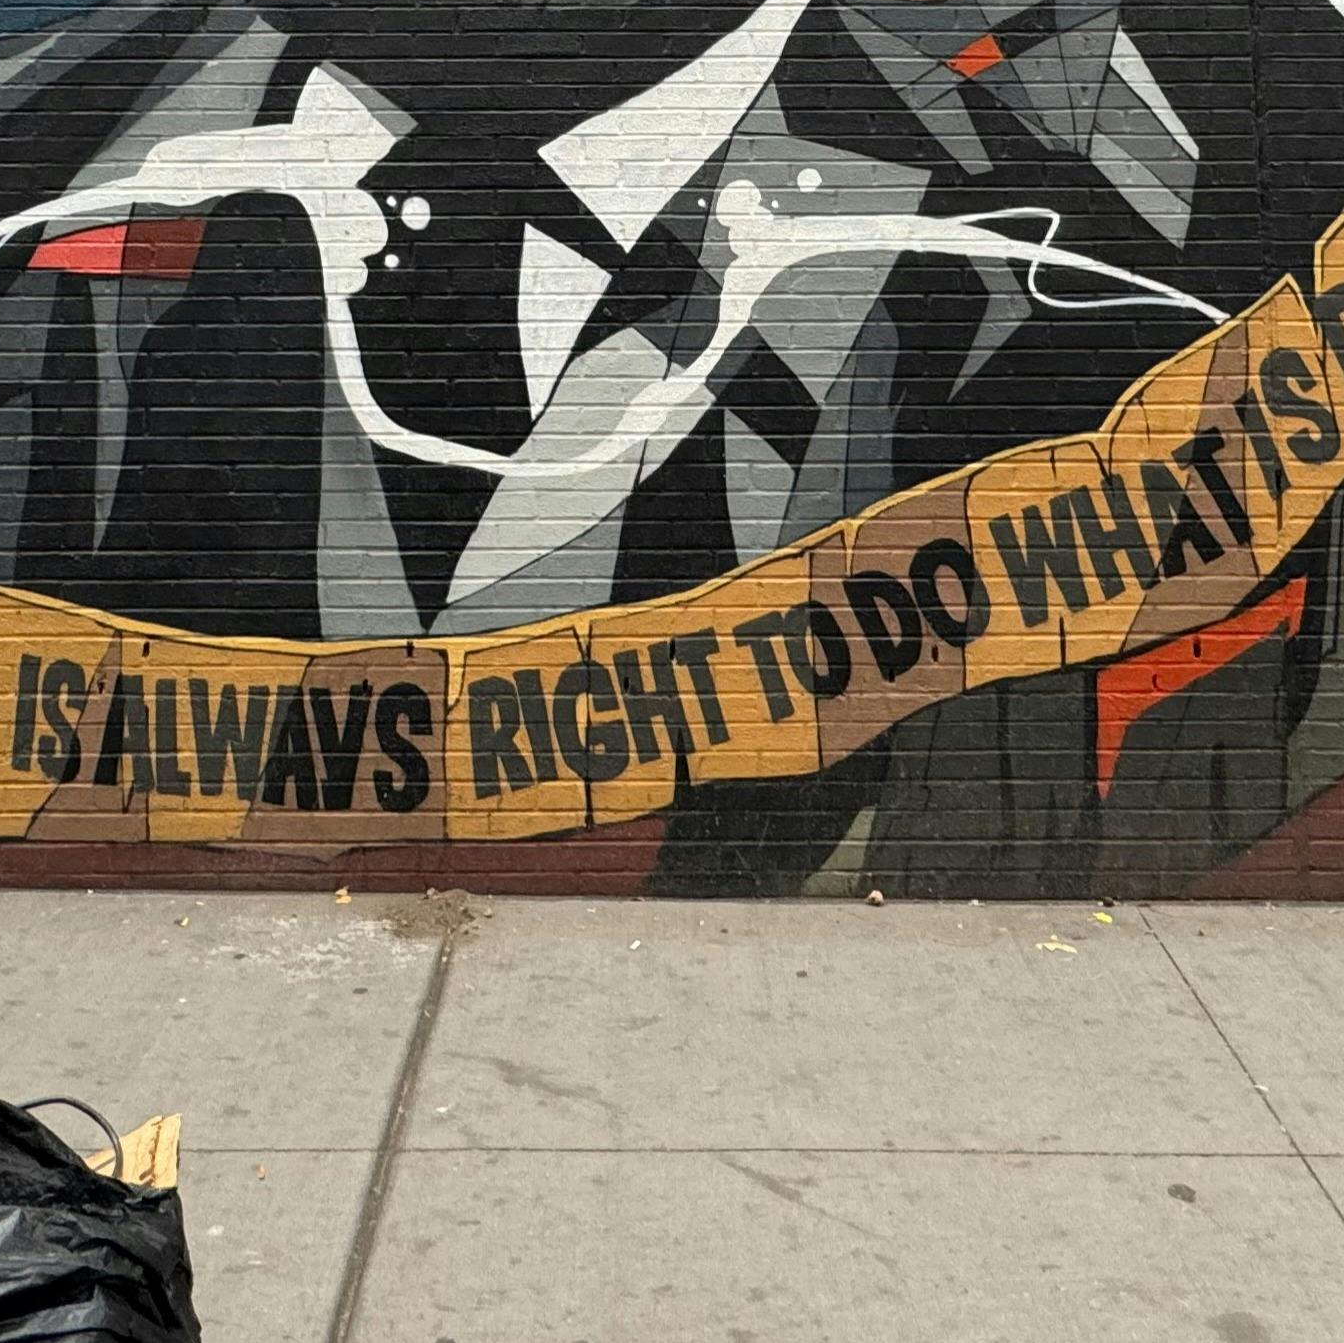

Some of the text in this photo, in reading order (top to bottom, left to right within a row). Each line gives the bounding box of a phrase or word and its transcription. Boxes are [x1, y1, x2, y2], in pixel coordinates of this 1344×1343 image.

[11, 652, 88, 785] IS
[93, 674, 433, 813] ALWAYS
[466, 626, 730, 801] RIGHT
[732, 599, 851, 723] TO
[843, 537, 991, 682] DO
[988, 427, 1255, 628] WHAT
[1233, 346, 1342, 500] IS
